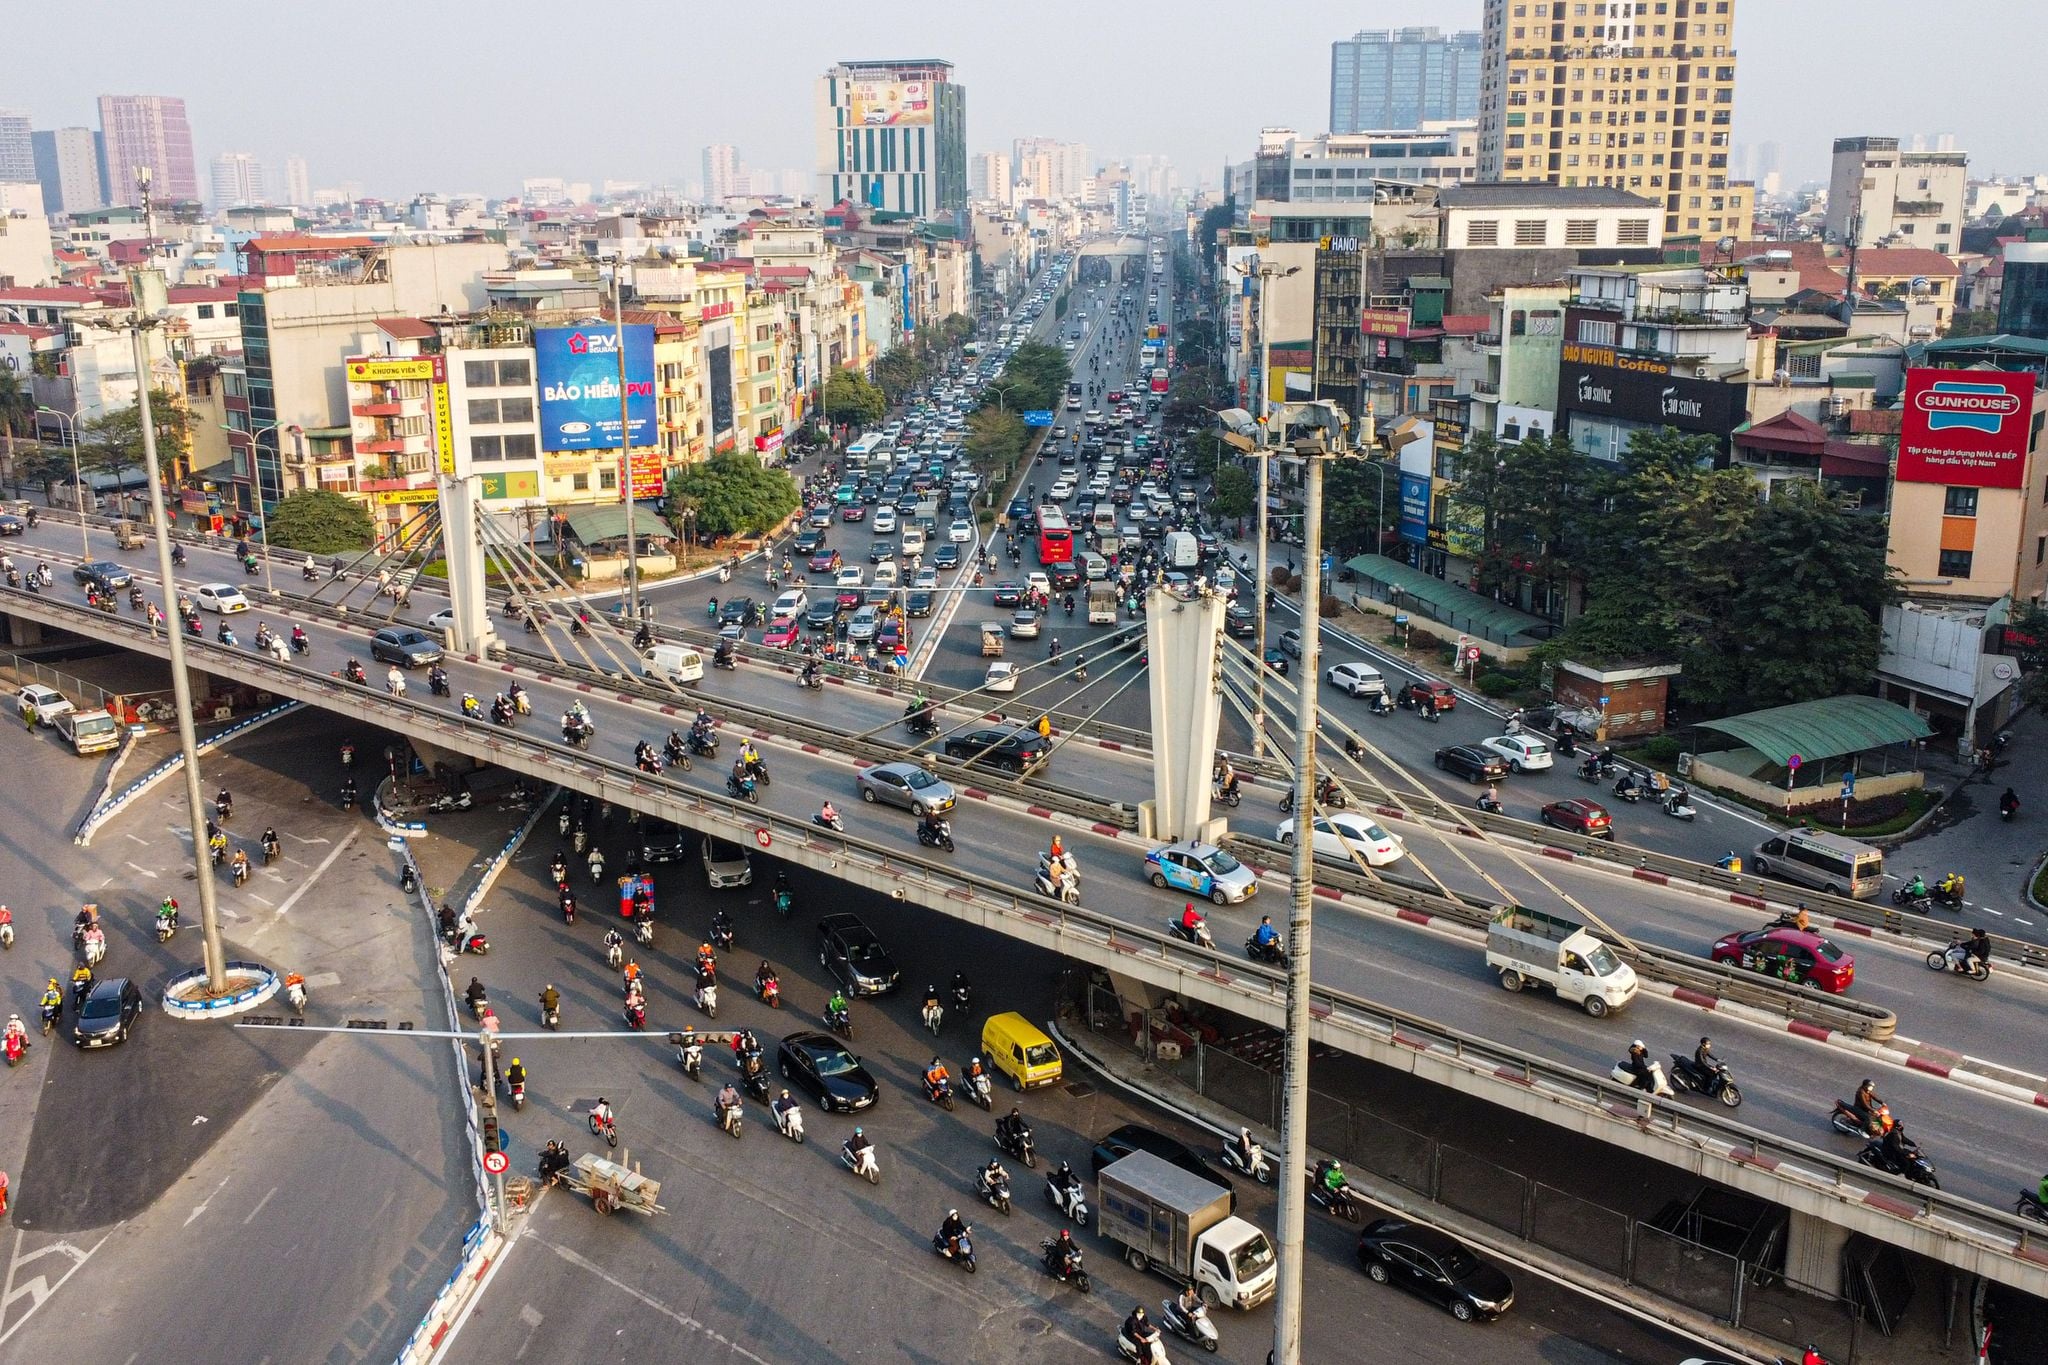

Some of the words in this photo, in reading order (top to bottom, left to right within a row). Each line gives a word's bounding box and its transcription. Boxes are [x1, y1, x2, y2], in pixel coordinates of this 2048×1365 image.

[1332, 237, 1358, 250] HANOI
[1564, 342, 1580, 361] ĐÀO
[1581, 347, 1615, 367] NGUYÊN
[1618, 358, 1668, 374] Coffee
[372, 367, 400, 375] KHƯƠNG
[400, 366, 416, 374] VIÊN
[544, 382, 581, 401] BẢO
[584, 376, 621, 398] HIỂM
[627, 382, 652, 396] PVI
[1584, 386, 1593, 400] 30
[1667, 398, 1678, 414] 30
[1925, 396, 2010, 410] SUNHOUSE
[1907, 446, 1921, 455] Tập
[1921, 447, 1942, 456] đoàn
[1943, 449, 1955, 457] gia
[1956, 450, 1976, 458] dụng
[1976, 450, 1993, 459] NHÀ
[2001, 449, 2018, 460] BẾP
[1925, 456, 1945, 465] hàng
[1946, 456, 1961, 465] đầu
[1962, 457, 1978, 468] Việt
[1978, 459, 1997, 467] Nam
[400, 493, 425, 502] KHƯƠNG
